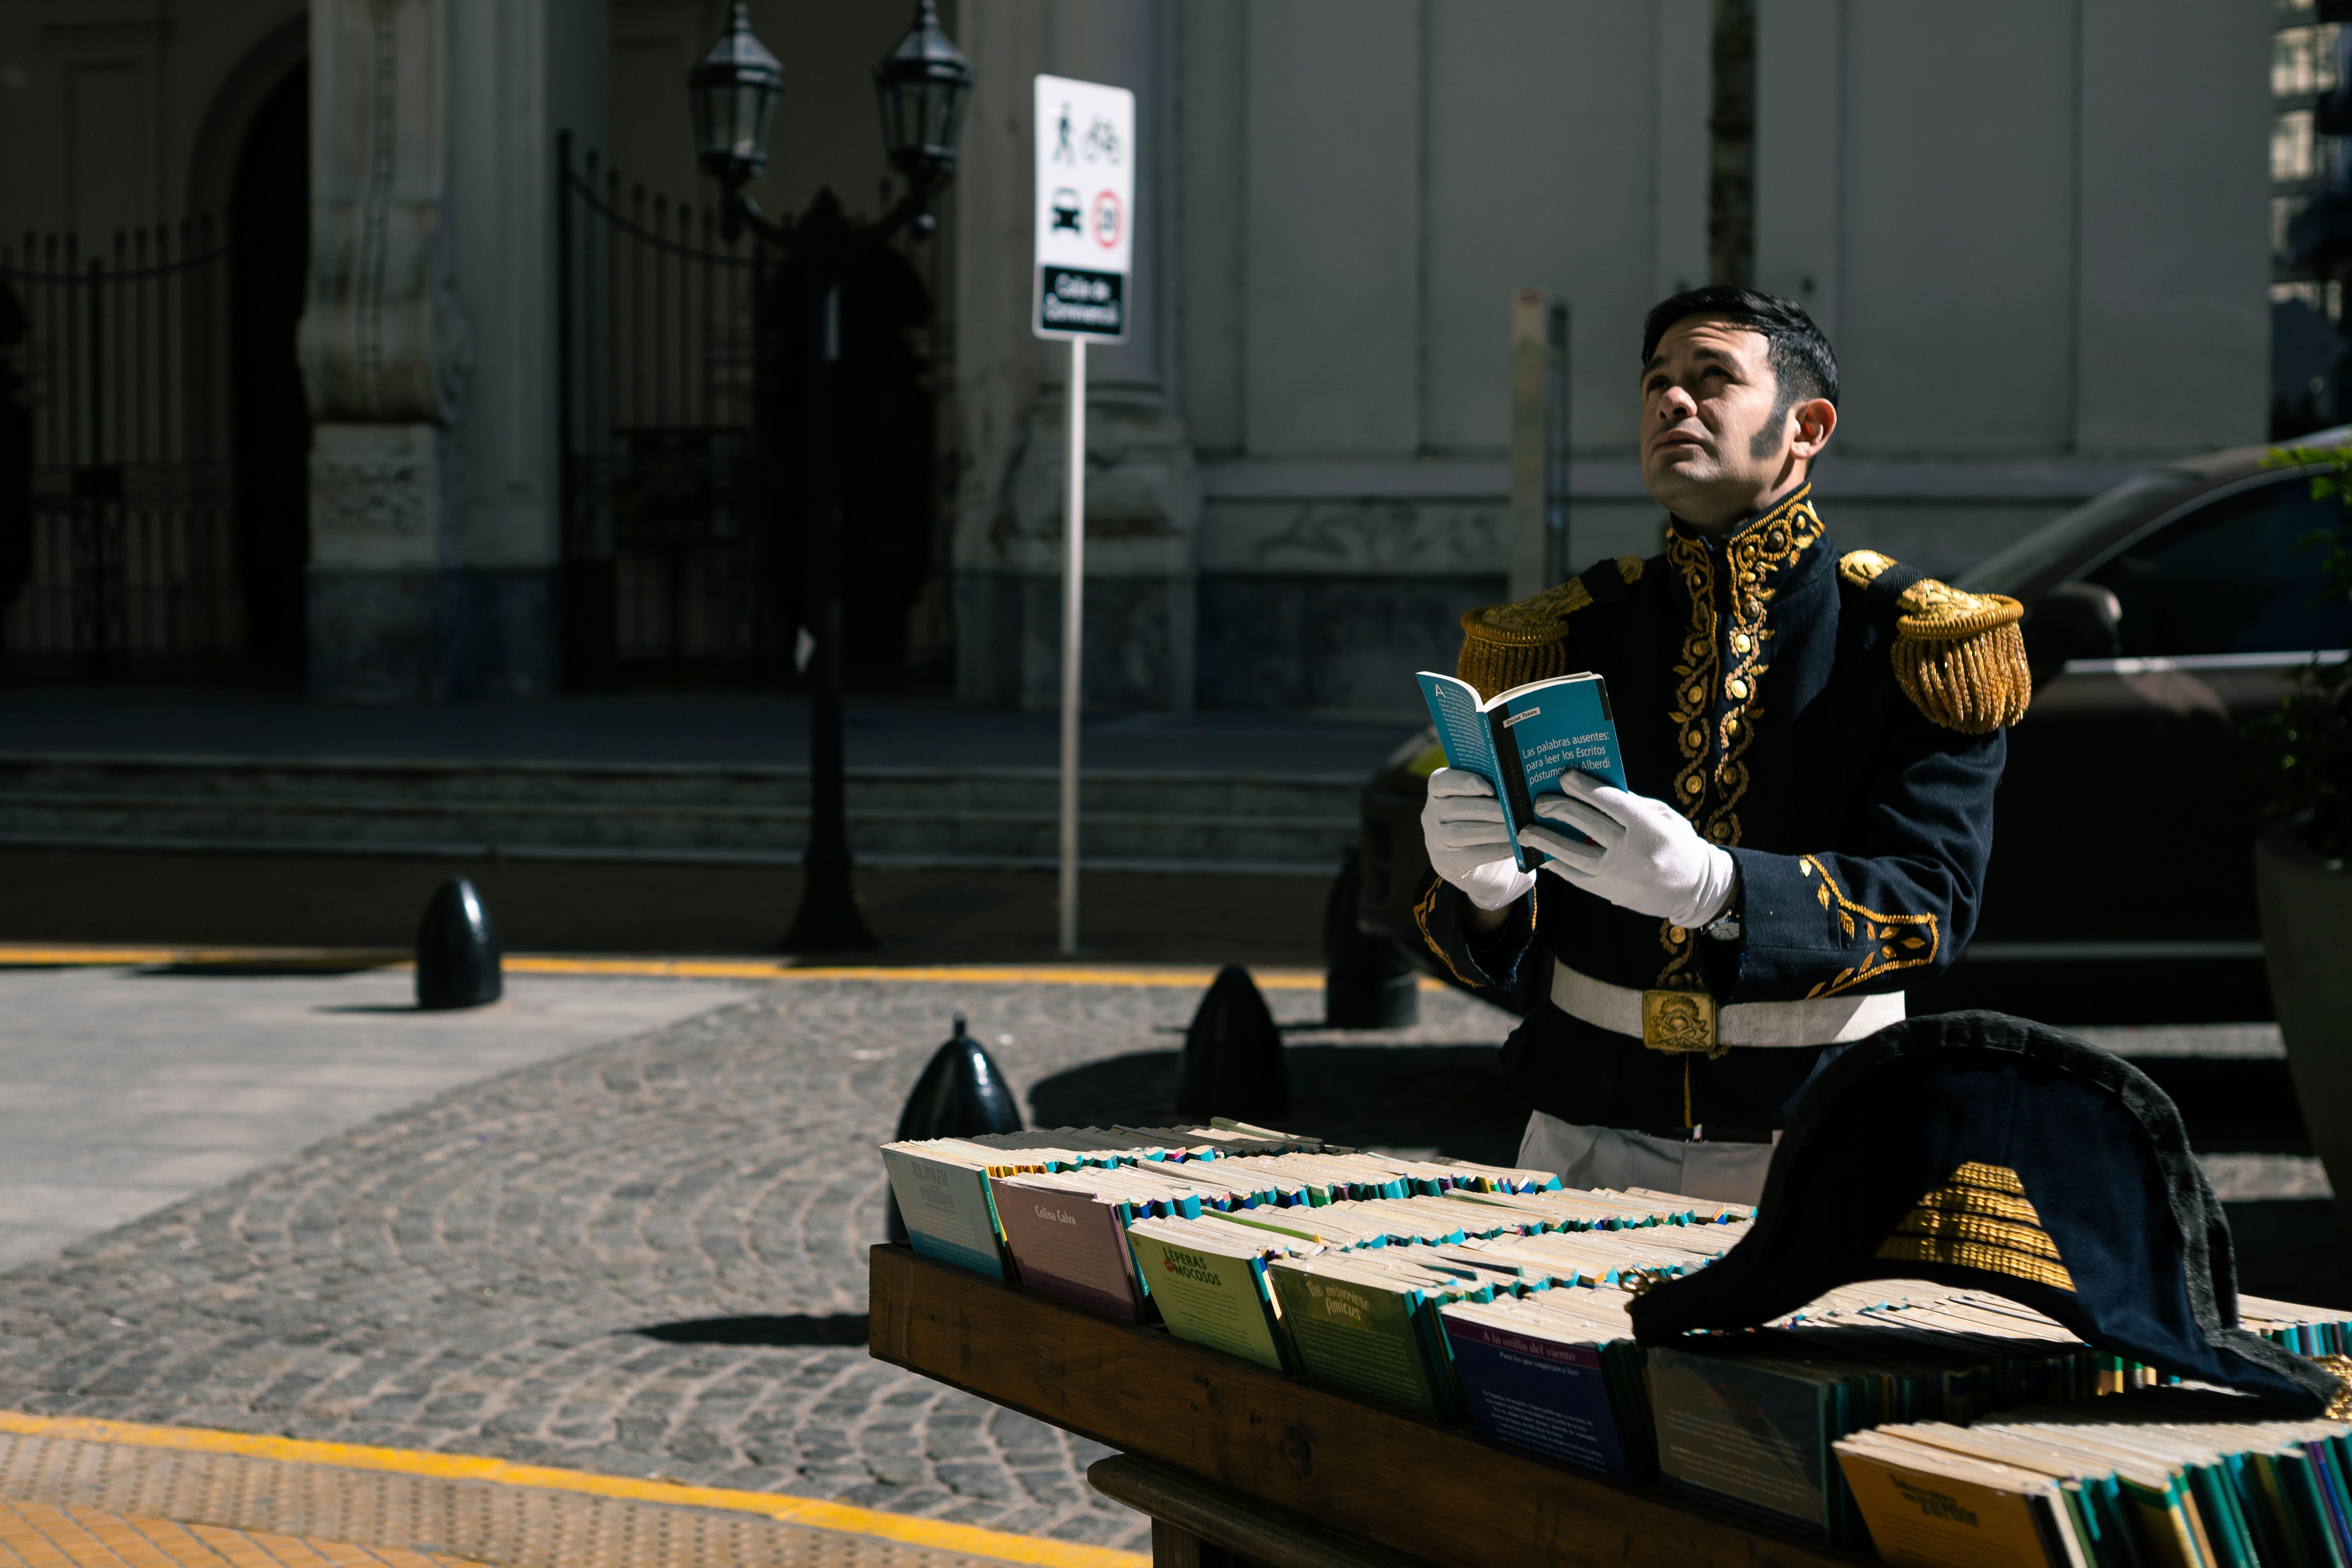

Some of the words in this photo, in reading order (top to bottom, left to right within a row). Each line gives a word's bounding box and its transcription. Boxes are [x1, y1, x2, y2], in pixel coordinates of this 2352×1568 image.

[1435, 684, 1446, 698] A
[1506, 717, 1521, 725] OSCAR
[1522, 710, 1537, 718] TERÁN
[1522, 748, 1535, 759] Las
[1536, 738, 1570, 756] palabras
[1573, 732, 1609, 744] ausentes:
[1526, 758, 1544, 774] para
[1545, 754, 1560, 764] leer
[1562, 750, 1574, 760] los
[1576, 746, 1606, 758] Escritos
[1529, 766, 1565, 787] póstumos
[1582, 758, 1610, 770] Alberdi
[1035, 1205, 1057, 1221] Colina
[1057, 1210, 1076, 1225] Calva
[1162, 1246, 1207, 1270] LÉPERAS
[1174, 1264, 1221, 1286] MOCOSOS
[1325, 1284, 1369, 1311] misterioso
[1325, 1297, 1361, 1321] Amicus
[1483, 1331, 1490, 1342] A
[1491, 1333, 1501, 1343] la
[1502, 1337, 1527, 1351] orilla
[1529, 1342, 1544, 1355] del
[1546, 1347, 1576, 1361] viento
[1499, 1351, 1513, 1361] Para
[1567, 1368, 1579, 1376] leer
